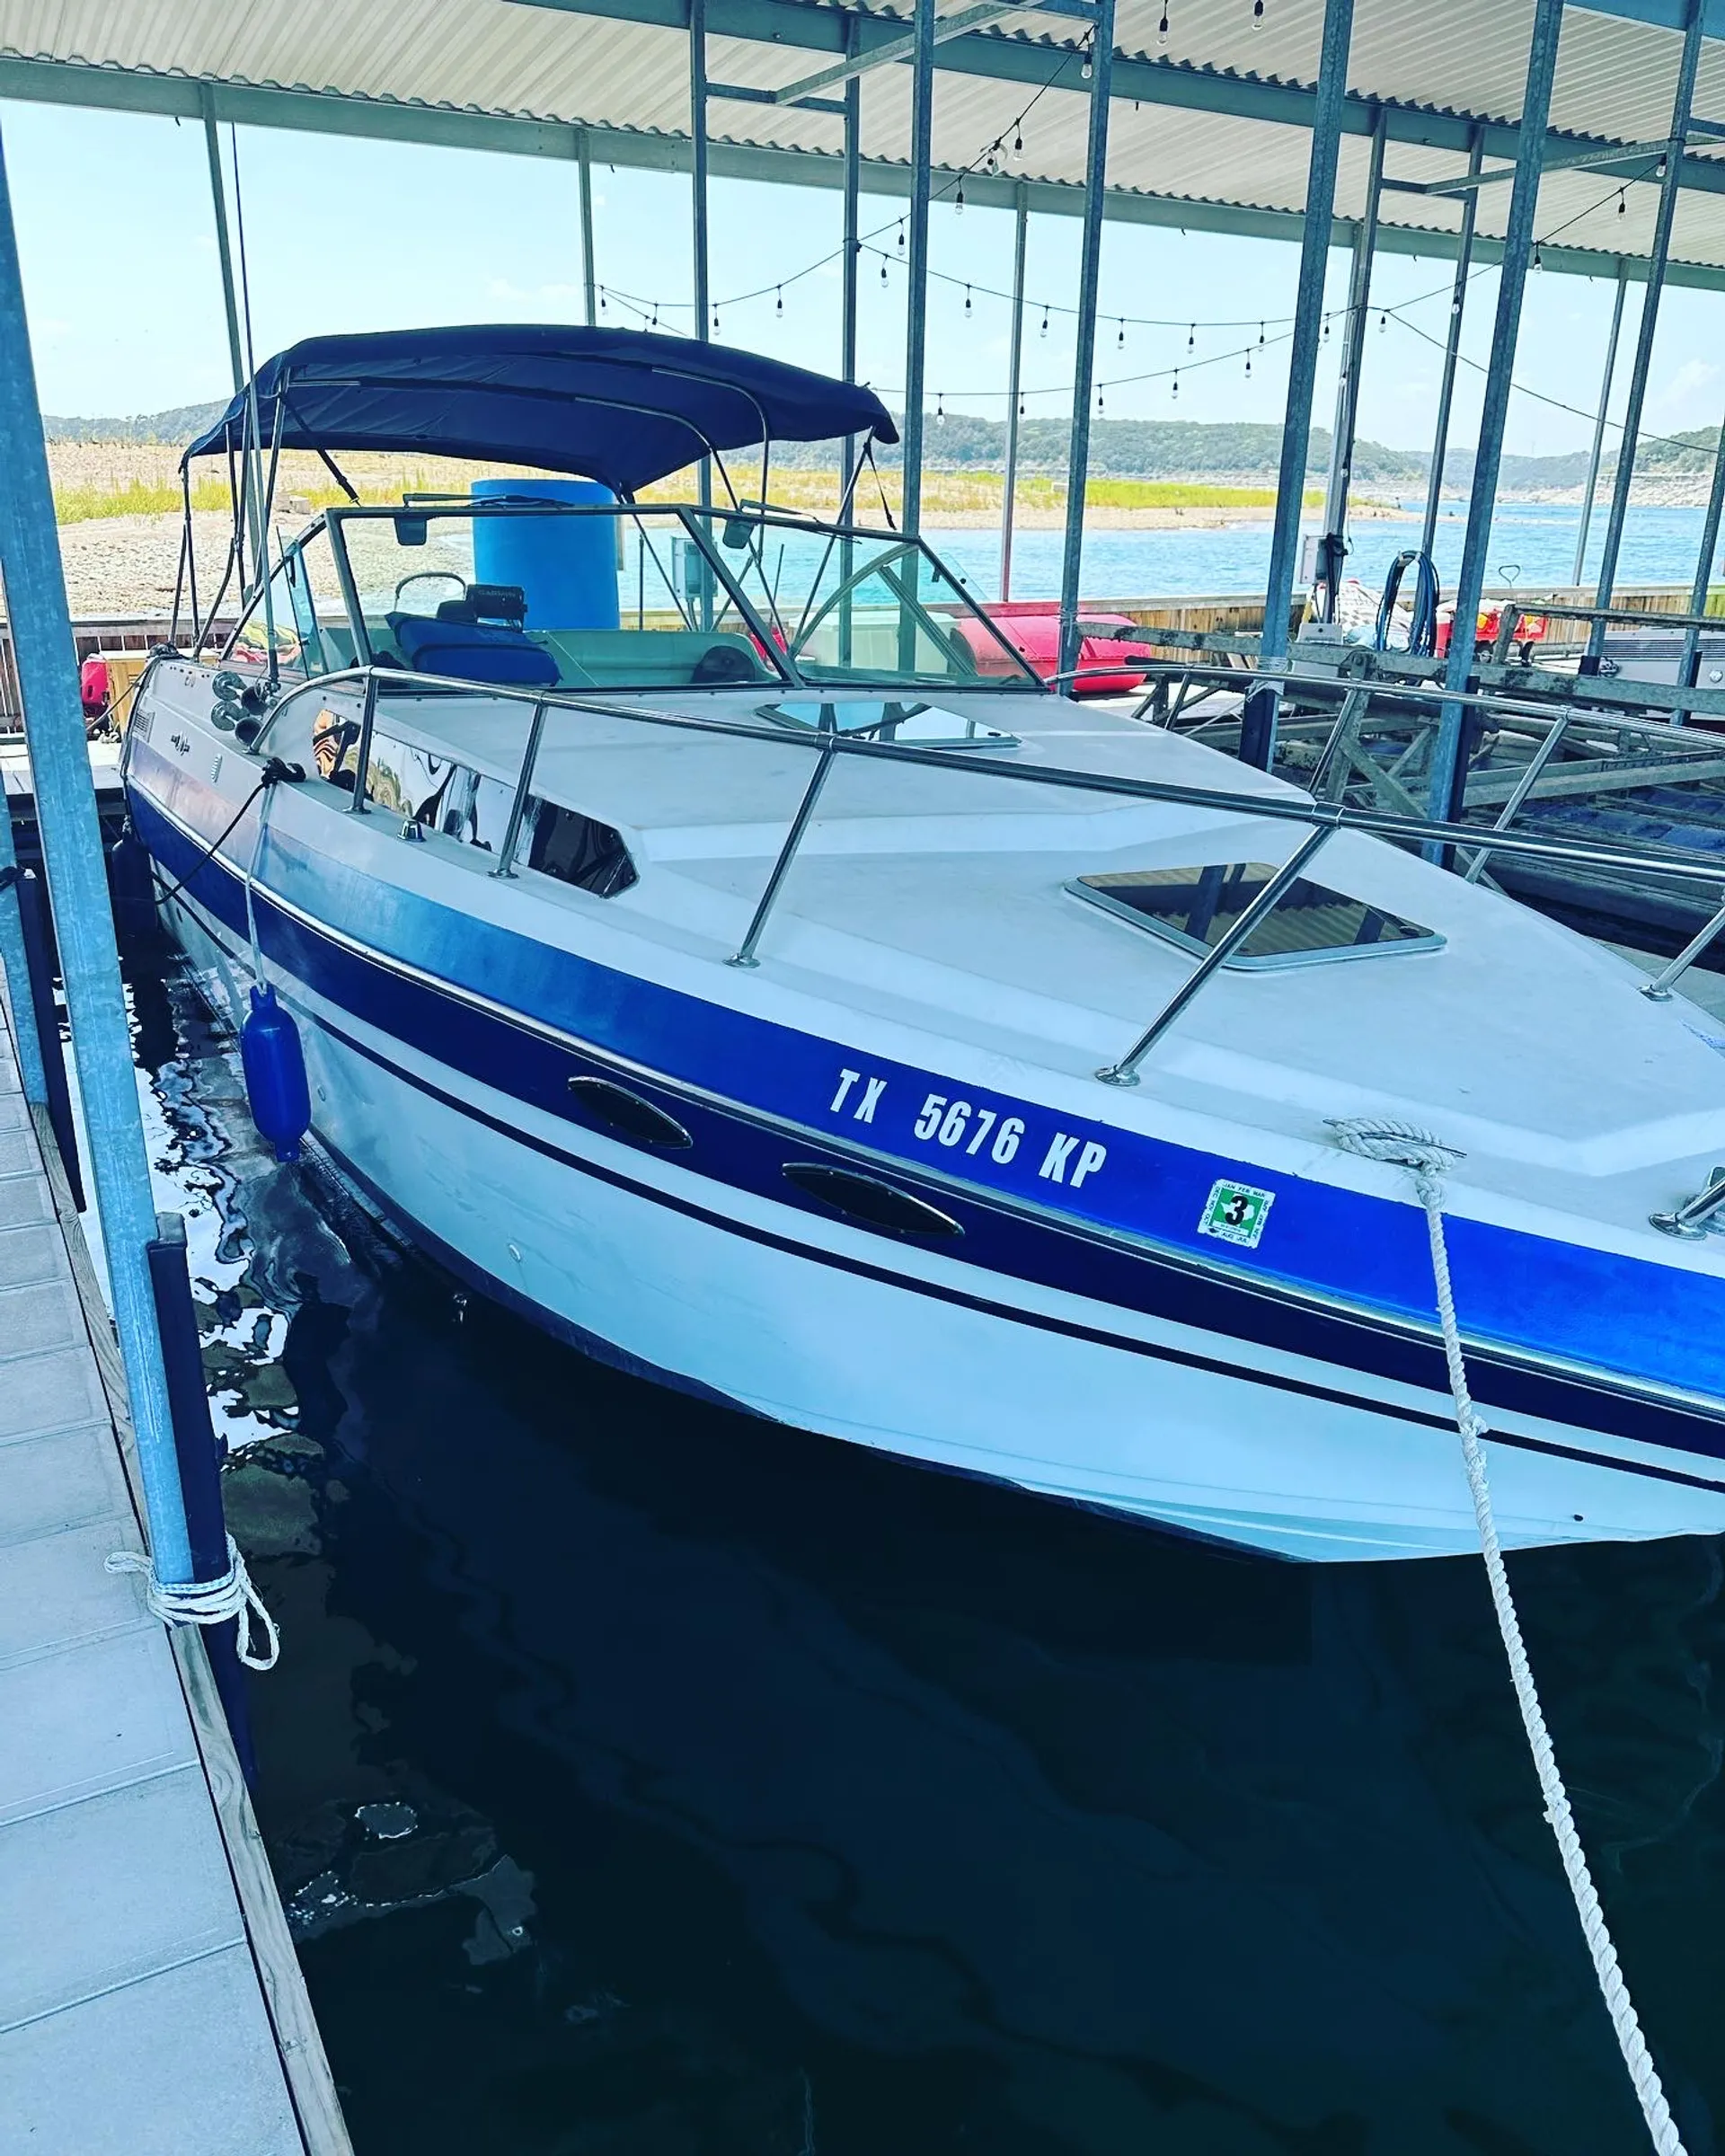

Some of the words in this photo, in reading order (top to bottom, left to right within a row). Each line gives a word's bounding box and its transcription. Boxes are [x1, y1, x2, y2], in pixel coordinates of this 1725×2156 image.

[829, 1068, 888, 1124] TX
[914, 1093, 1025, 1164] 5676
[1038, 1132, 1107, 1188] KP
[1225, 1195, 1249, 1226] 3
